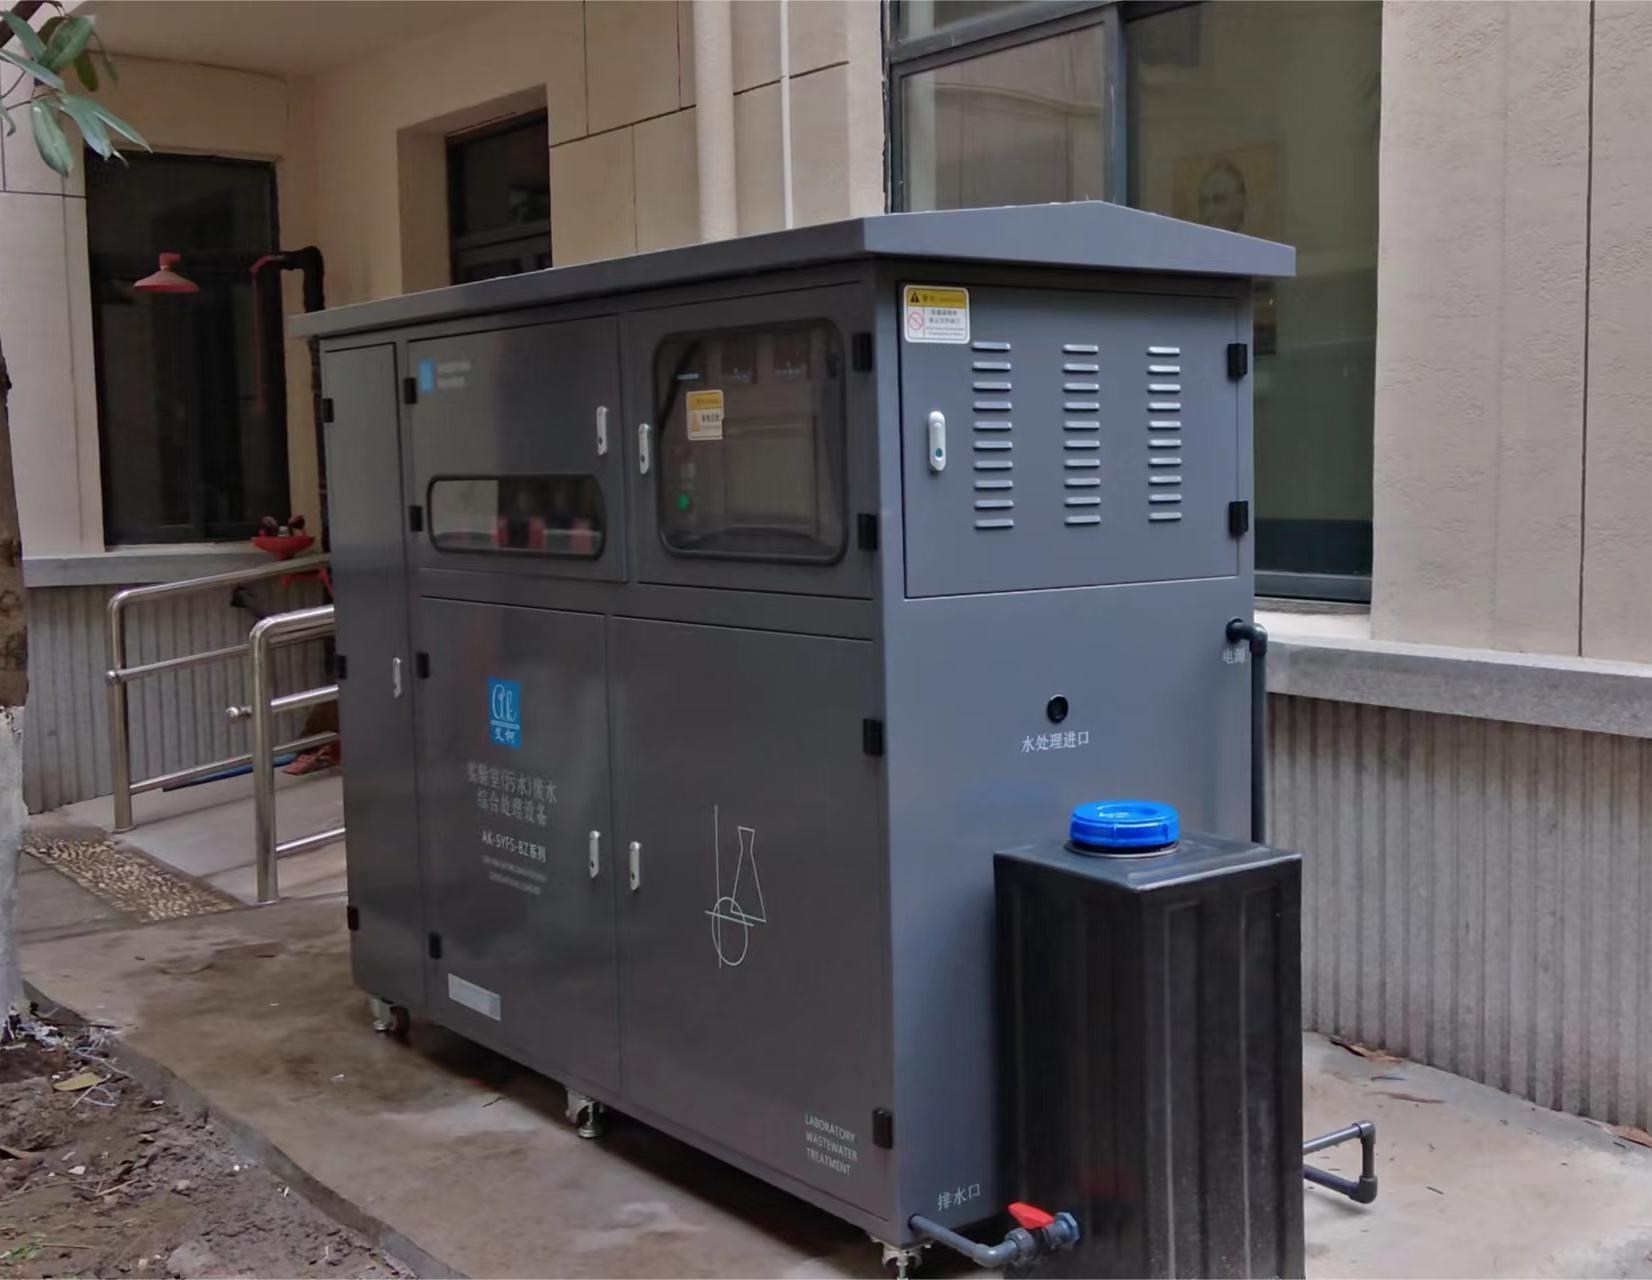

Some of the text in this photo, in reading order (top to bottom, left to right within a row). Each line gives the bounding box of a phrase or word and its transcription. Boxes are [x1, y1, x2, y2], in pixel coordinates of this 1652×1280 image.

[1021, 730, 1089, 752] 水处理进口
[805, 1112, 855, 1142] LABORATORY
[805, 1130, 858, 1162] WASTEWATER
[806, 1147, 851, 1176] TREATMENT
[937, 1183, 980, 1211] 排水口
